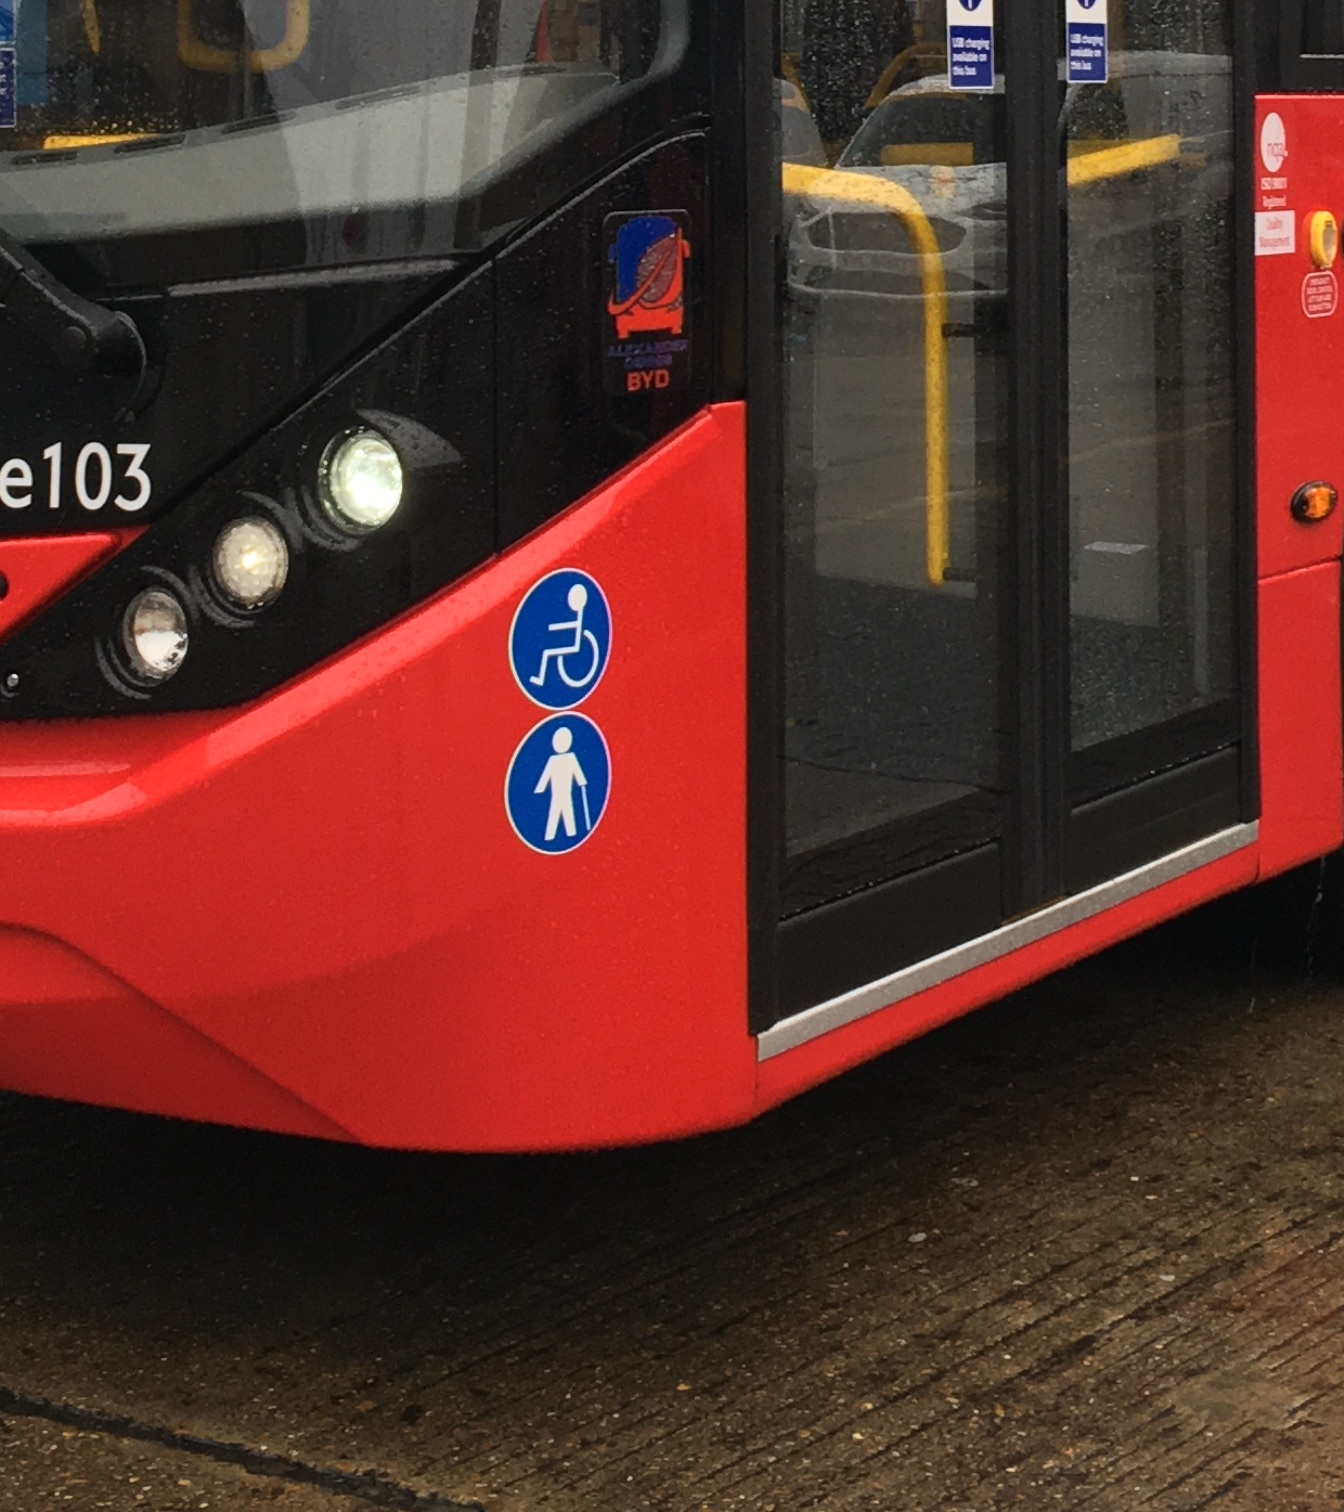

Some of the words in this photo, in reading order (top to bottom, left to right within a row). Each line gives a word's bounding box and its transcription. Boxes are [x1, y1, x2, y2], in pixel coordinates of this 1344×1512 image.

[965, 38, 990, 50] charging
[953, 51, 978, 62] available
[626, 369, 670, 391] BYD
